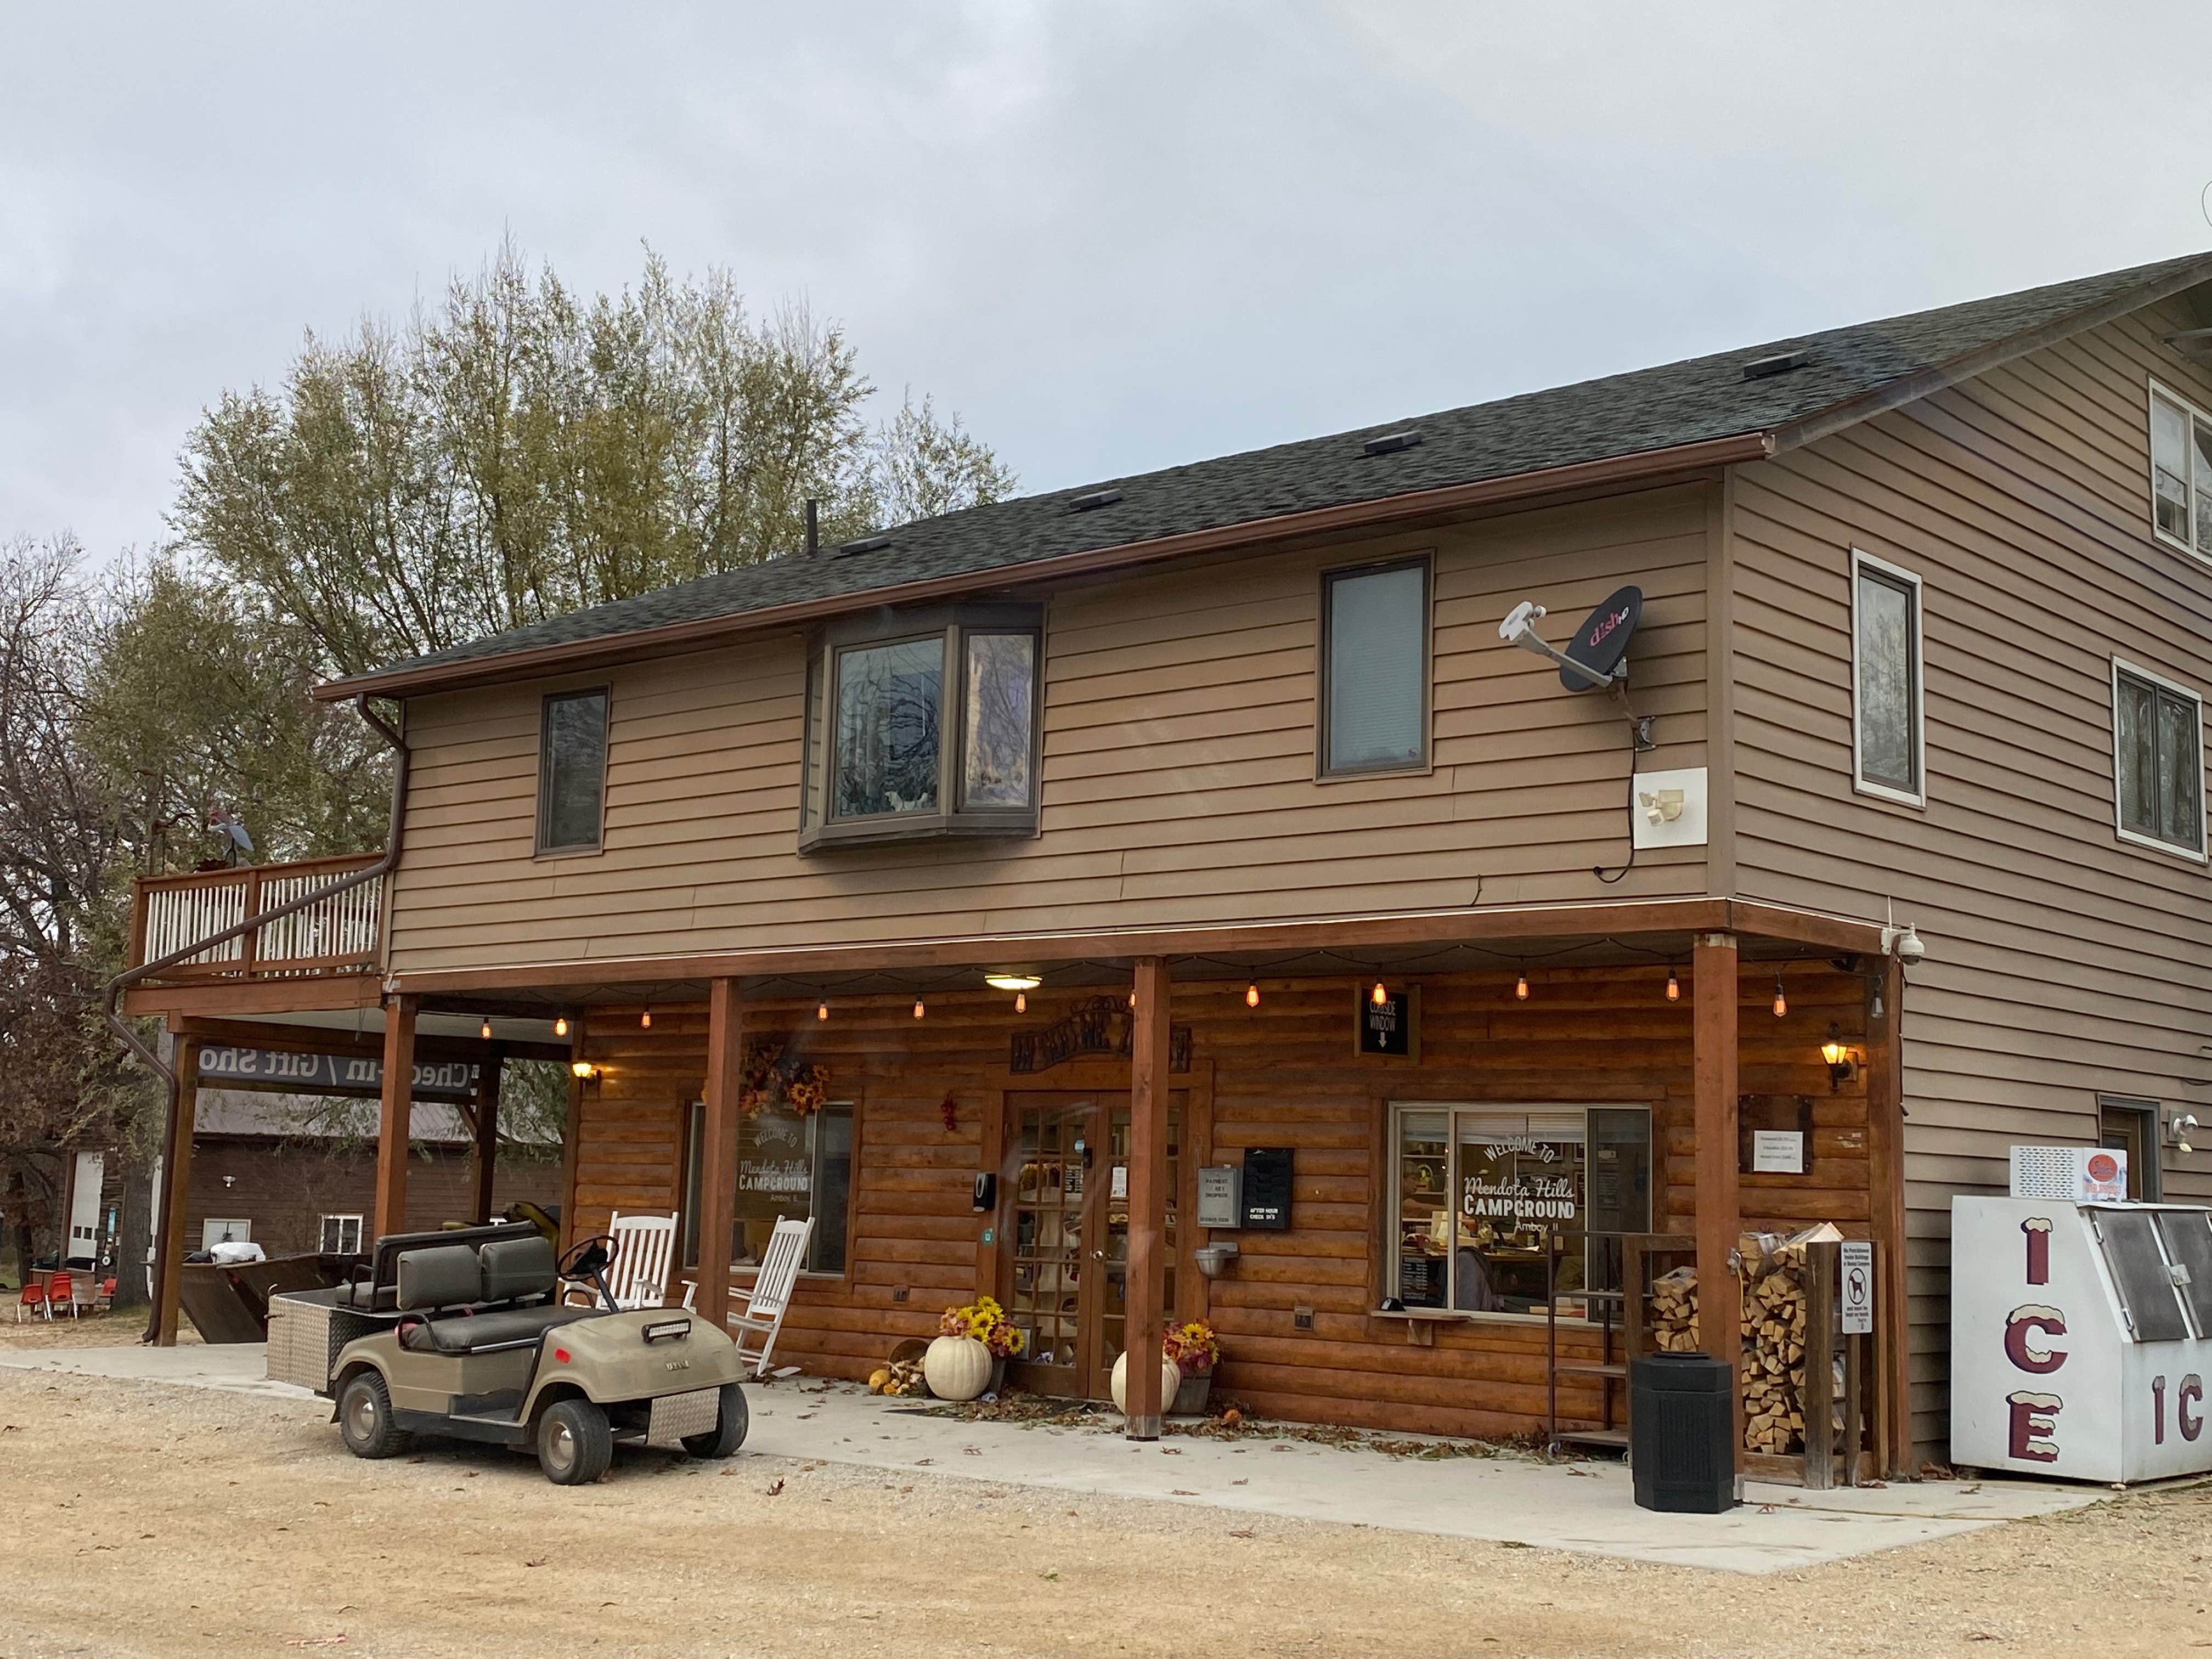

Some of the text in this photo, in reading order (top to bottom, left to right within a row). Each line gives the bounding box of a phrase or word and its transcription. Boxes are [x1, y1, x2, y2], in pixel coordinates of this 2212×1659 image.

[1369, 1014, 1396, 1031] WINDOW
[753, 1126, 799, 1148] WELCOME TO
[1483, 1136, 1555, 1164] WELCOME TO
[740, 1159, 808, 1175] Mendota Hills
[739, 1174, 808, 1191] CAMPGROUND
[1464, 1176, 1530, 1197] Mendota
[1535, 1178, 1575, 1198] Hills
[1464, 1194, 1575, 1220] CAMPGROUND
[2004, 1217, 2069, 1463] ICE
[2152, 1373, 2204, 1445] IC
